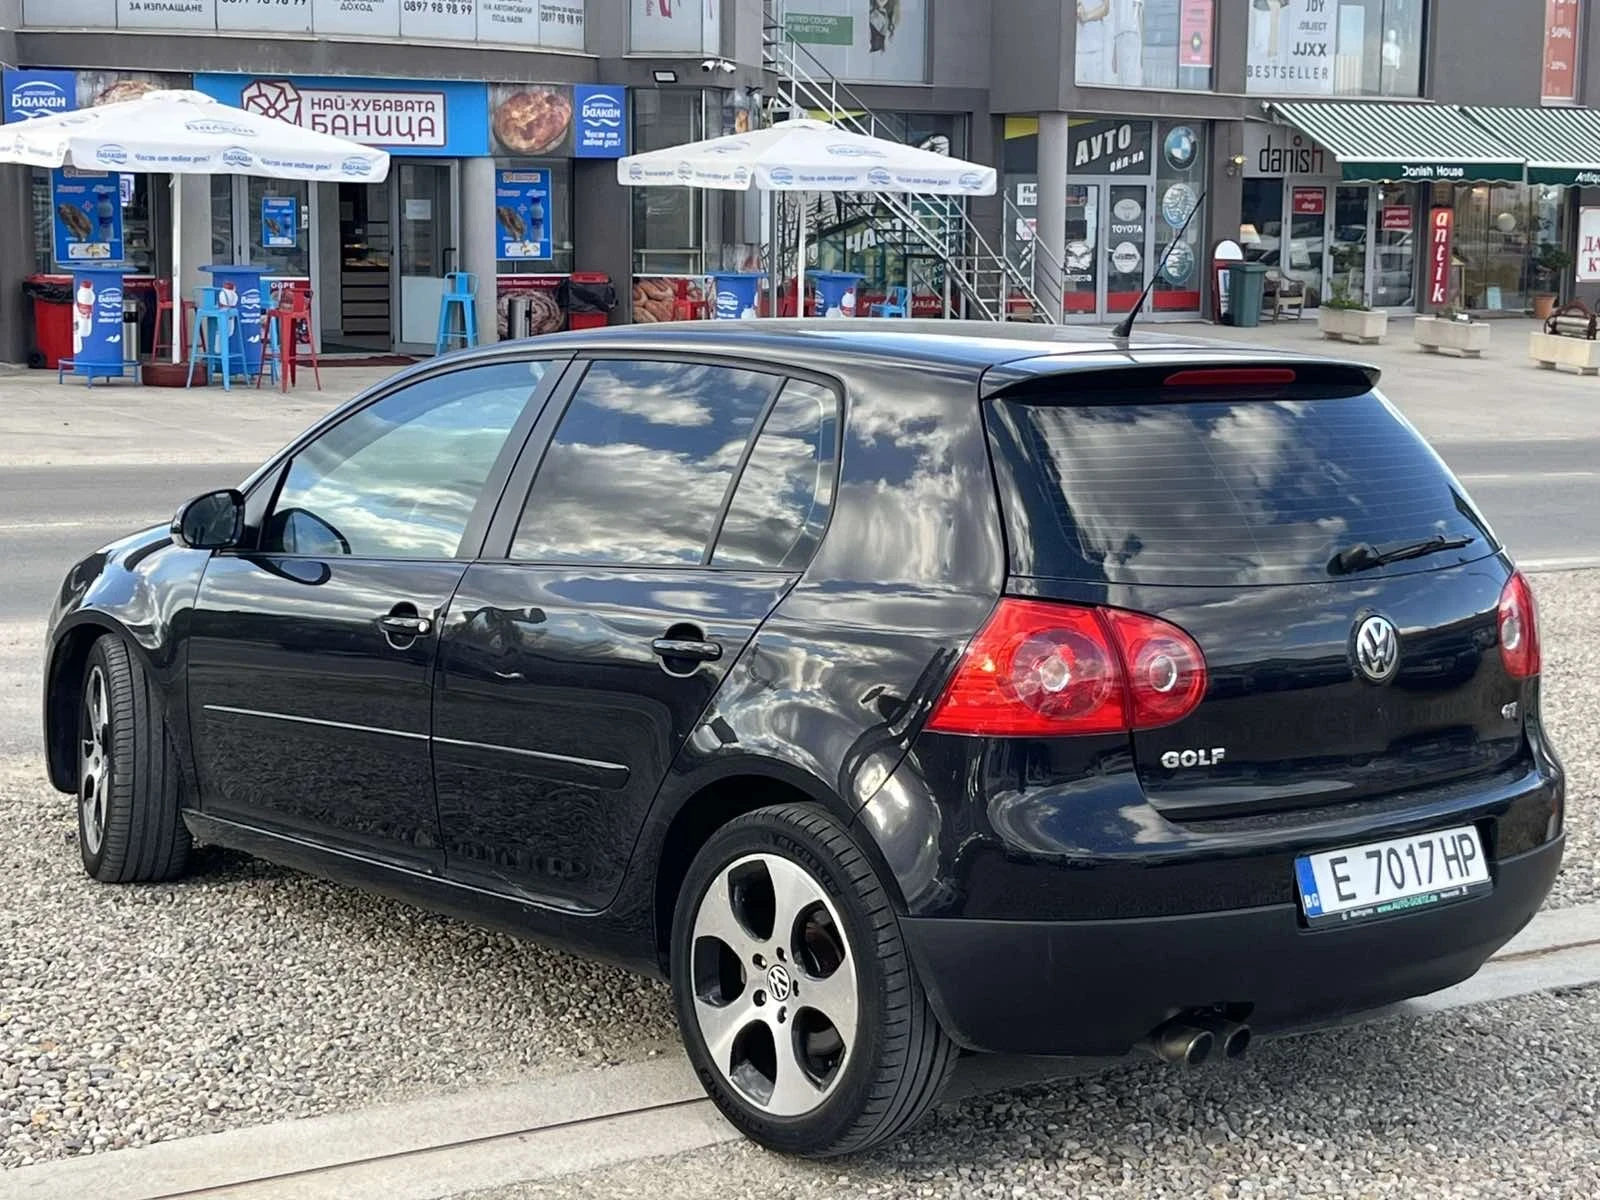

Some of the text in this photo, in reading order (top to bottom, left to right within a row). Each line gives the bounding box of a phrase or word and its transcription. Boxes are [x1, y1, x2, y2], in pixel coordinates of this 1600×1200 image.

[129, 2, 203, 13] ЗА ИЗПЛАЩАНЕ
[340, 2, 373, 12] ДОХОД
[403, 2, 473, 15] 0897 98 98 99
[540, 12, 556, 22] 0897
[557, 13, 566, 24] 98
[575, 15, 583, 26] 99
[1292, 42, 1327, 57] JJXX
[1247, 64, 1329, 80] BESTSELLER
[11, 93, 67, 107] Балкан
[310, 94, 436, 113] НАЙ-ХУБАВАТА
[582, 104, 621, 118] Балкан
[310, 113, 436, 142] БАНИЦА
[1258, 134, 1324, 174] danish
[1402, 165, 1464, 177] Danish House
[1111, 224, 1143, 234] TOYOTA
[1431, 211, 1449, 303] antik
[1160, 747, 1226, 769] GOLF
[1328, 832, 1476, 902] E 7017 HP
[1304, 893, 1320, 909] BG
